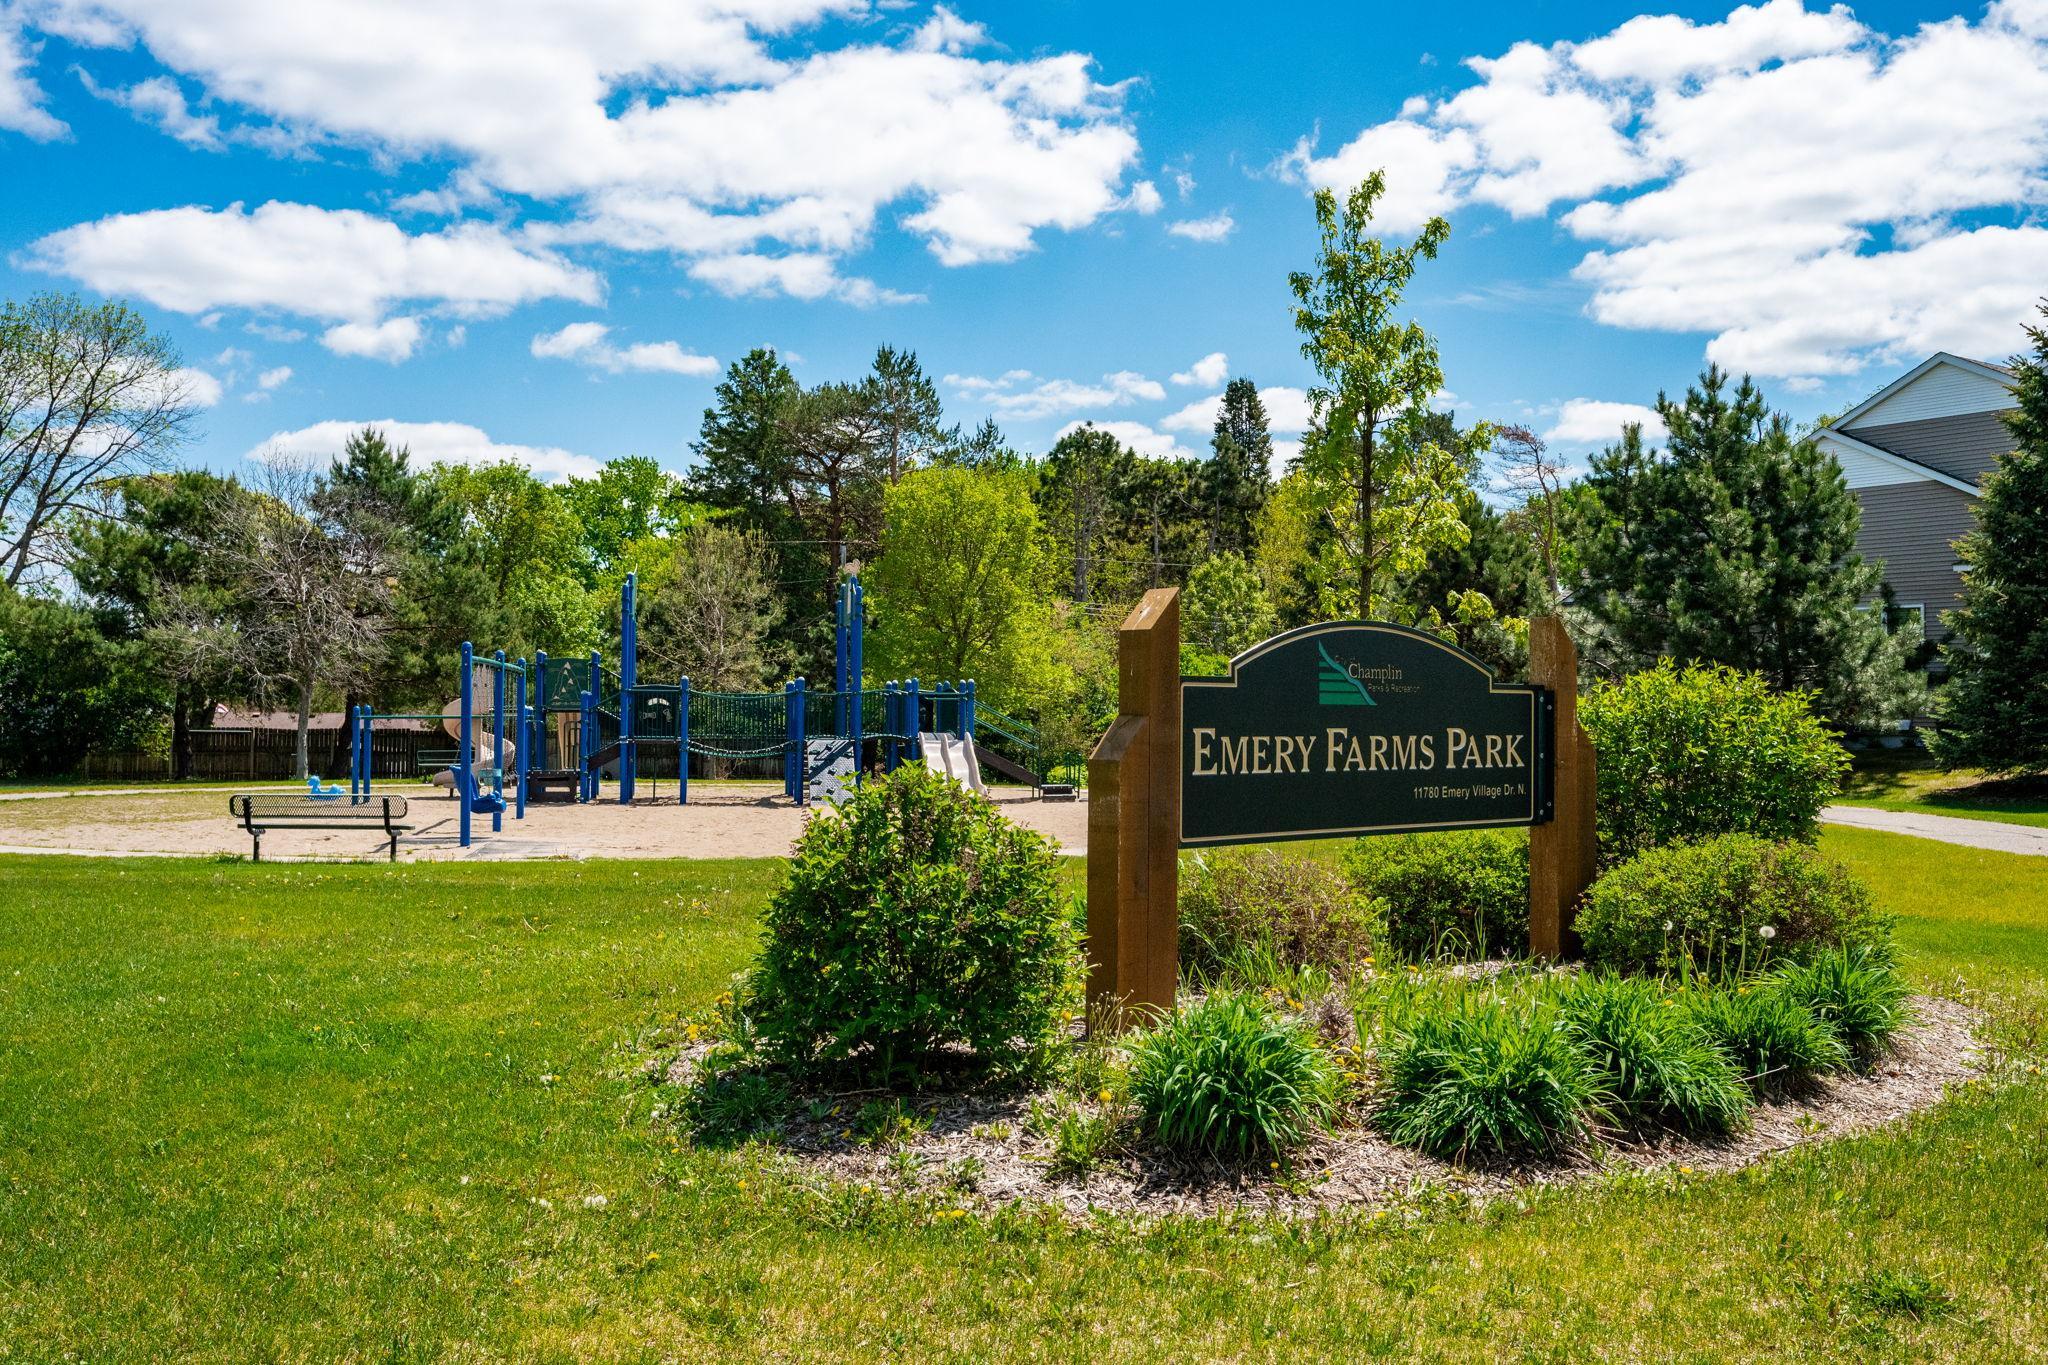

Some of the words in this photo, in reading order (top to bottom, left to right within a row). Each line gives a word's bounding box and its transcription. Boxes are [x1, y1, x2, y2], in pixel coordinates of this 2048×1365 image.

[1348, 663, 1403, 683] Champlin
[1192, 727, 1317, 776] EMERY
[1325, 727, 1435, 772] FARMS
[1446, 727, 1525, 769] PARK
[1413, 786, 1439, 799] 11780
[1441, 785, 1470, 800] Emery
[1472, 784, 1501, 799] Village
[1503, 783, 1515, 796] Dr.
[1517, 783, 1527, 795] N.
